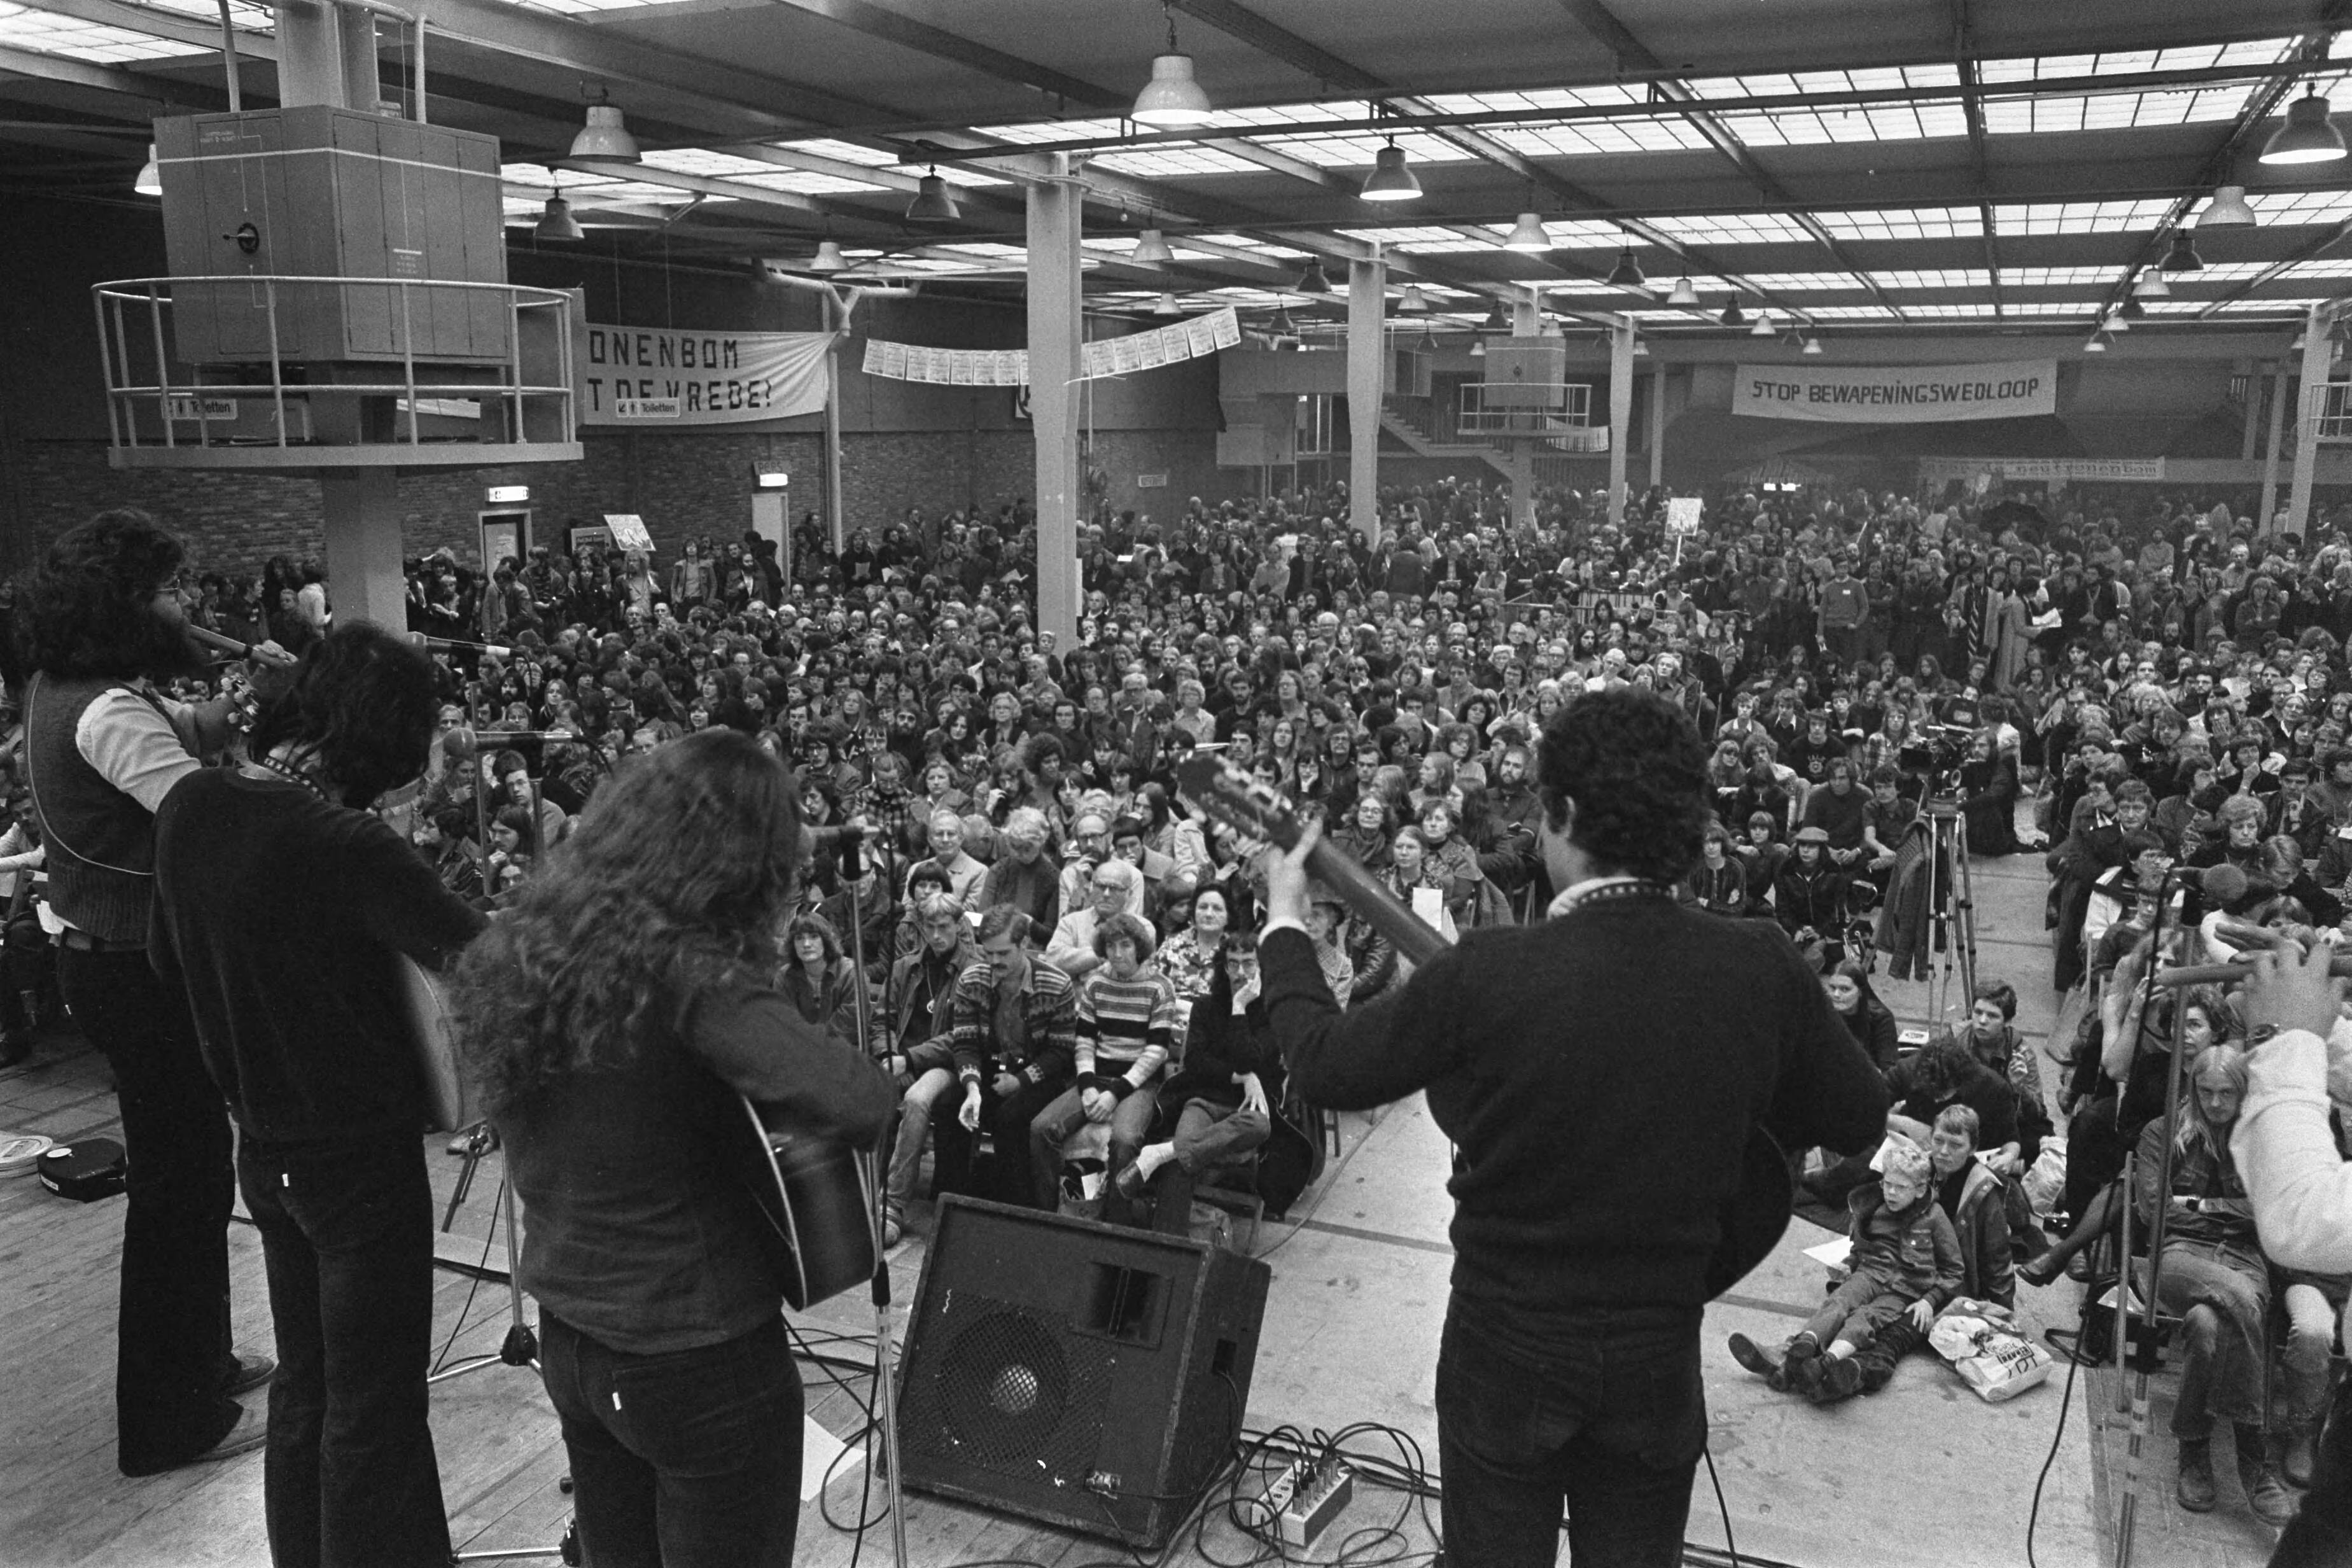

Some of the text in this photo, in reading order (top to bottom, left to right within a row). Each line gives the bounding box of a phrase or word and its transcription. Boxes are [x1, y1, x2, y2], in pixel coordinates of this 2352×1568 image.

[589, 330, 738, 369] ONENBOM
[587, 378, 603, 411] T
[1752, 381, 1801, 402] STOP
[190, 401, 230, 414] Toetten
[641, 402, 675, 414] Toiletten
